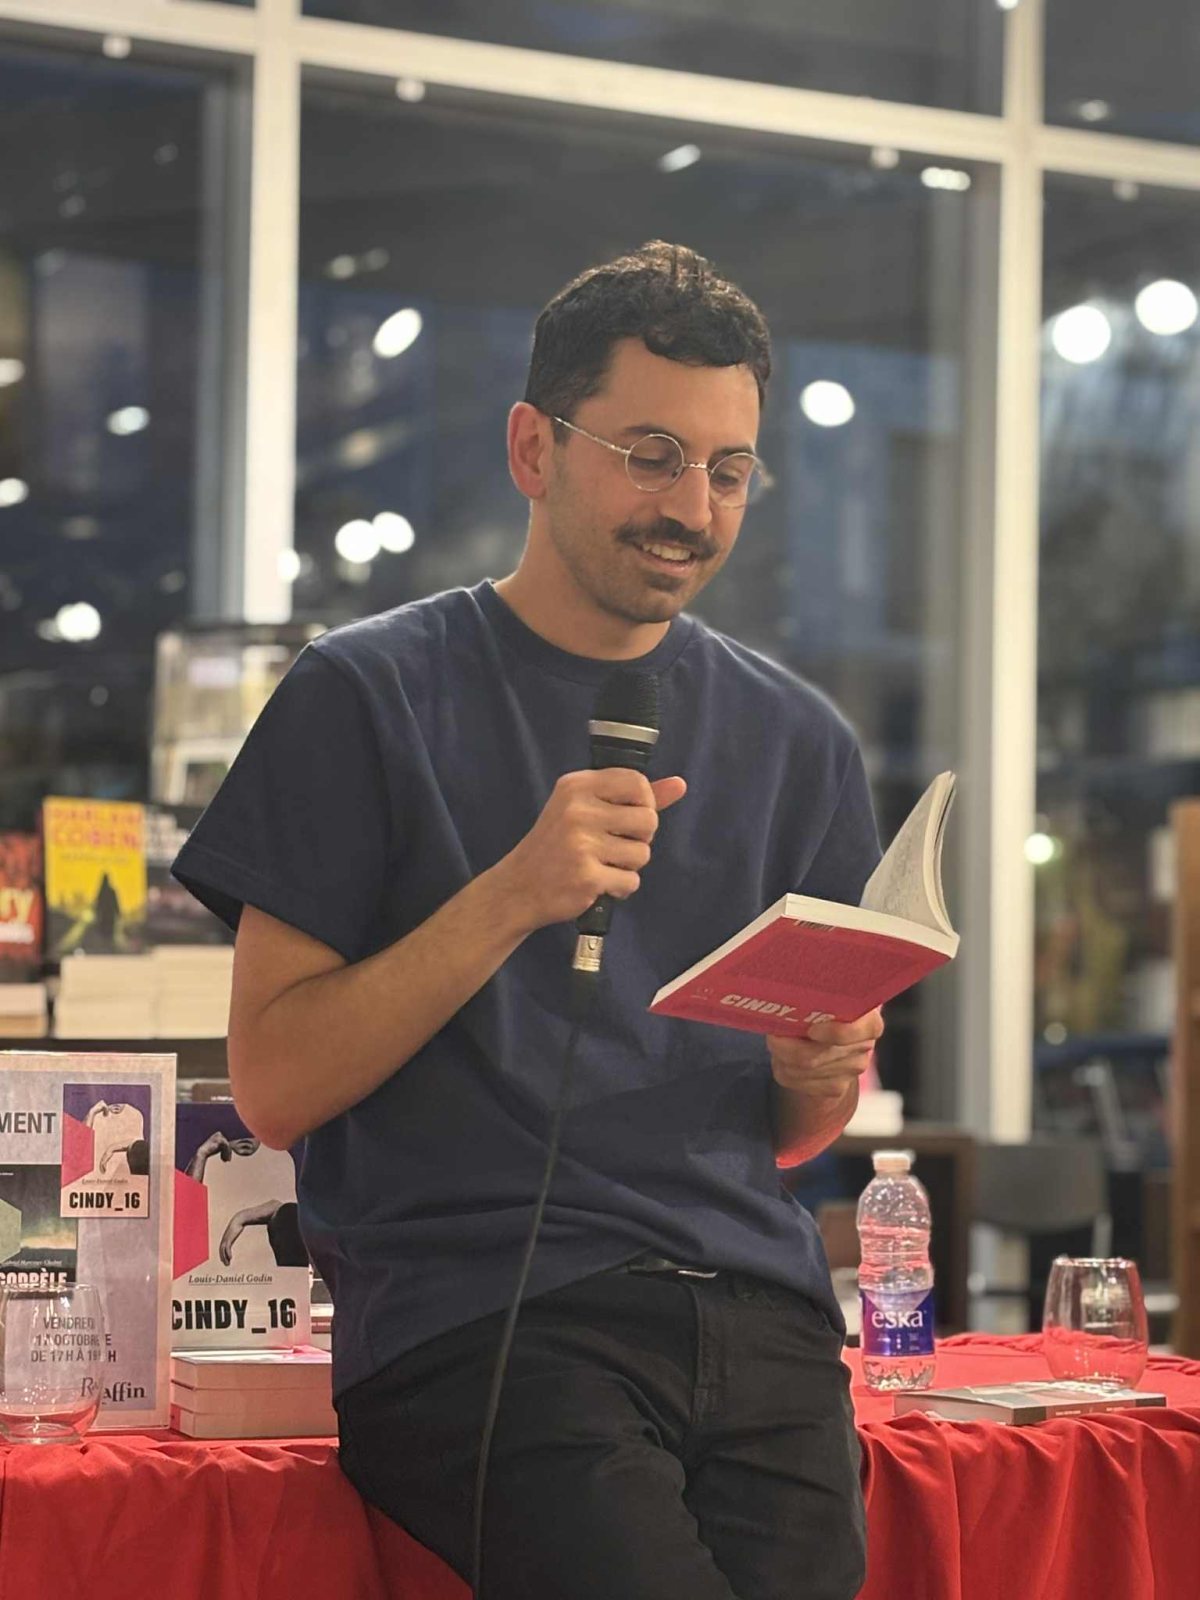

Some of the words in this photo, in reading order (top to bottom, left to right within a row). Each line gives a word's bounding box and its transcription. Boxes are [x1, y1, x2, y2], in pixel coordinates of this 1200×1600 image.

[69, 1192, 140, 1212] CINDY_16
[188, 1274, 245, 1284] Louis-Daniel
[246, 1273, 273, 1283] Godin
[172, 1298, 297, 1333] CINDY_16
[871, 1310, 924, 1328] eska
[31, 1350, 47, 1362] DE
